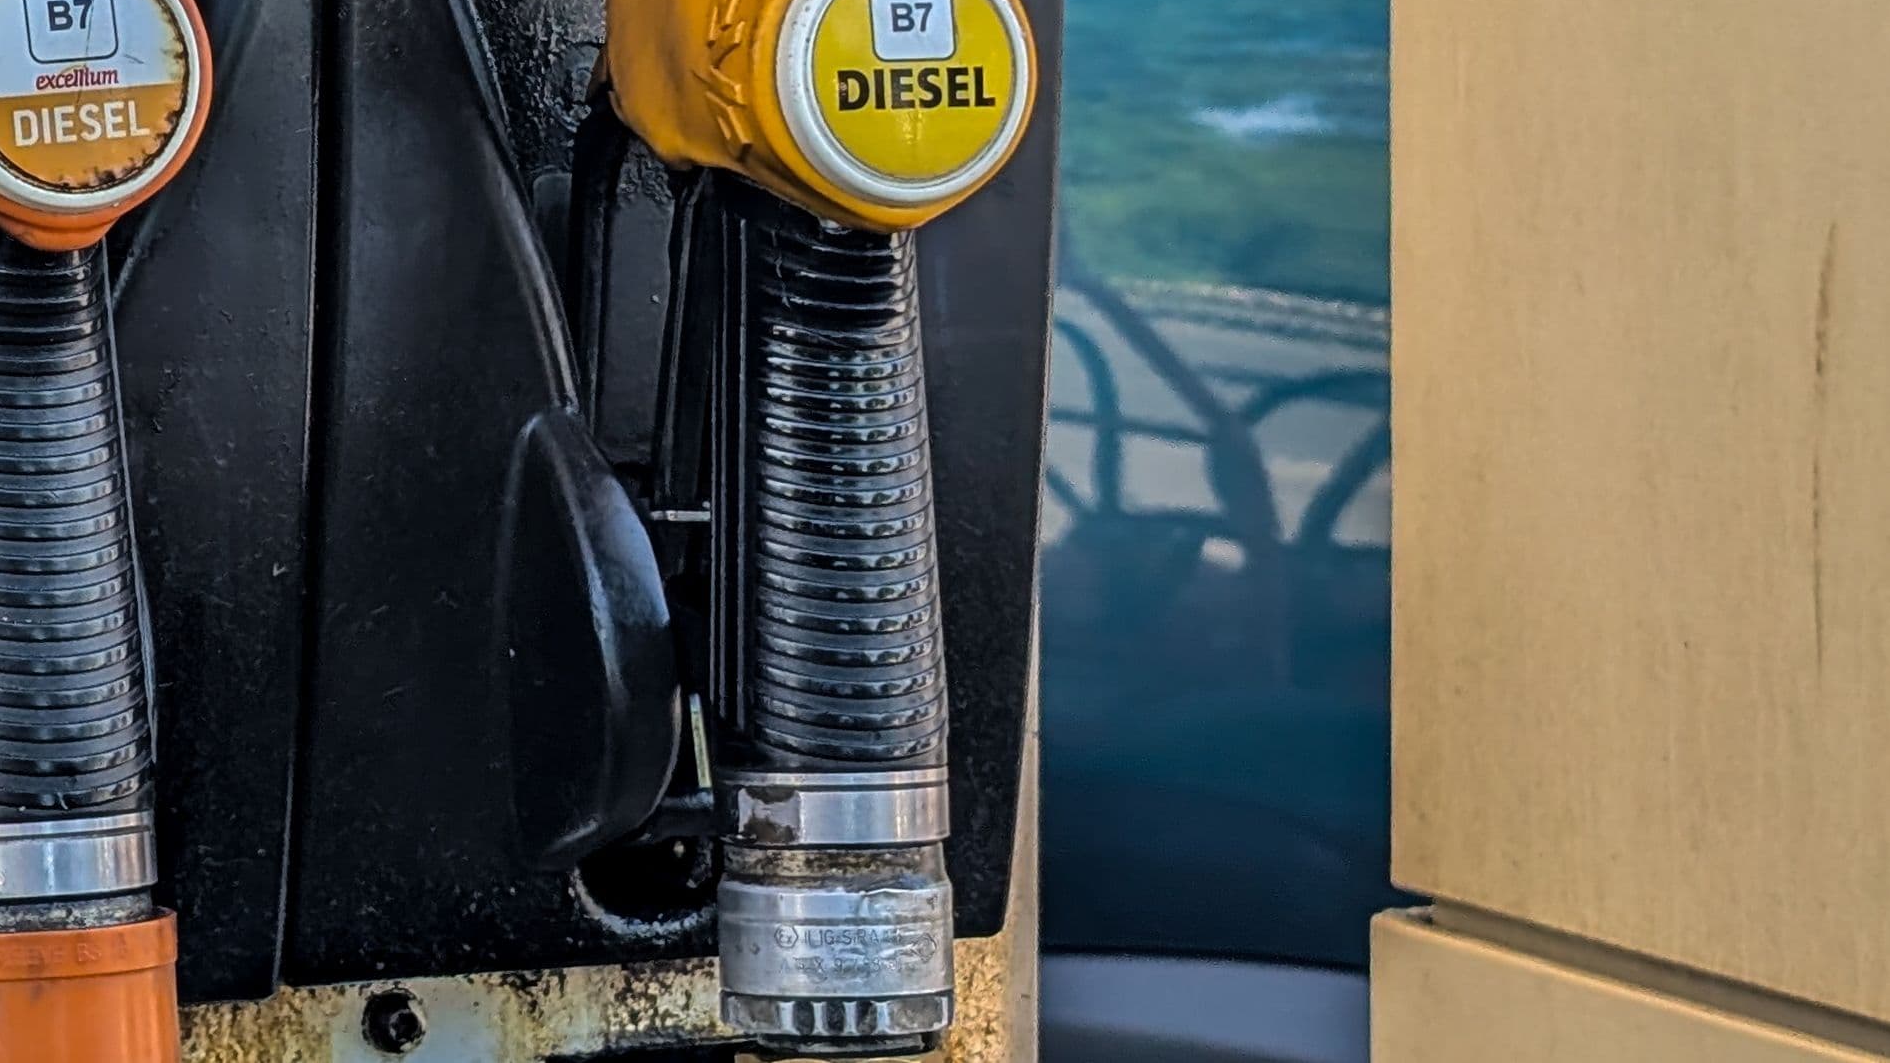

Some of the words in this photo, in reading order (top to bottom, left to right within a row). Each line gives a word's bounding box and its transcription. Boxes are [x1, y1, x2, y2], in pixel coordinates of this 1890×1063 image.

[890, 2, 933, 33] B7
[837, 66, 996, 111] DIESEL
[13, 100, 150, 147] DIESEL
